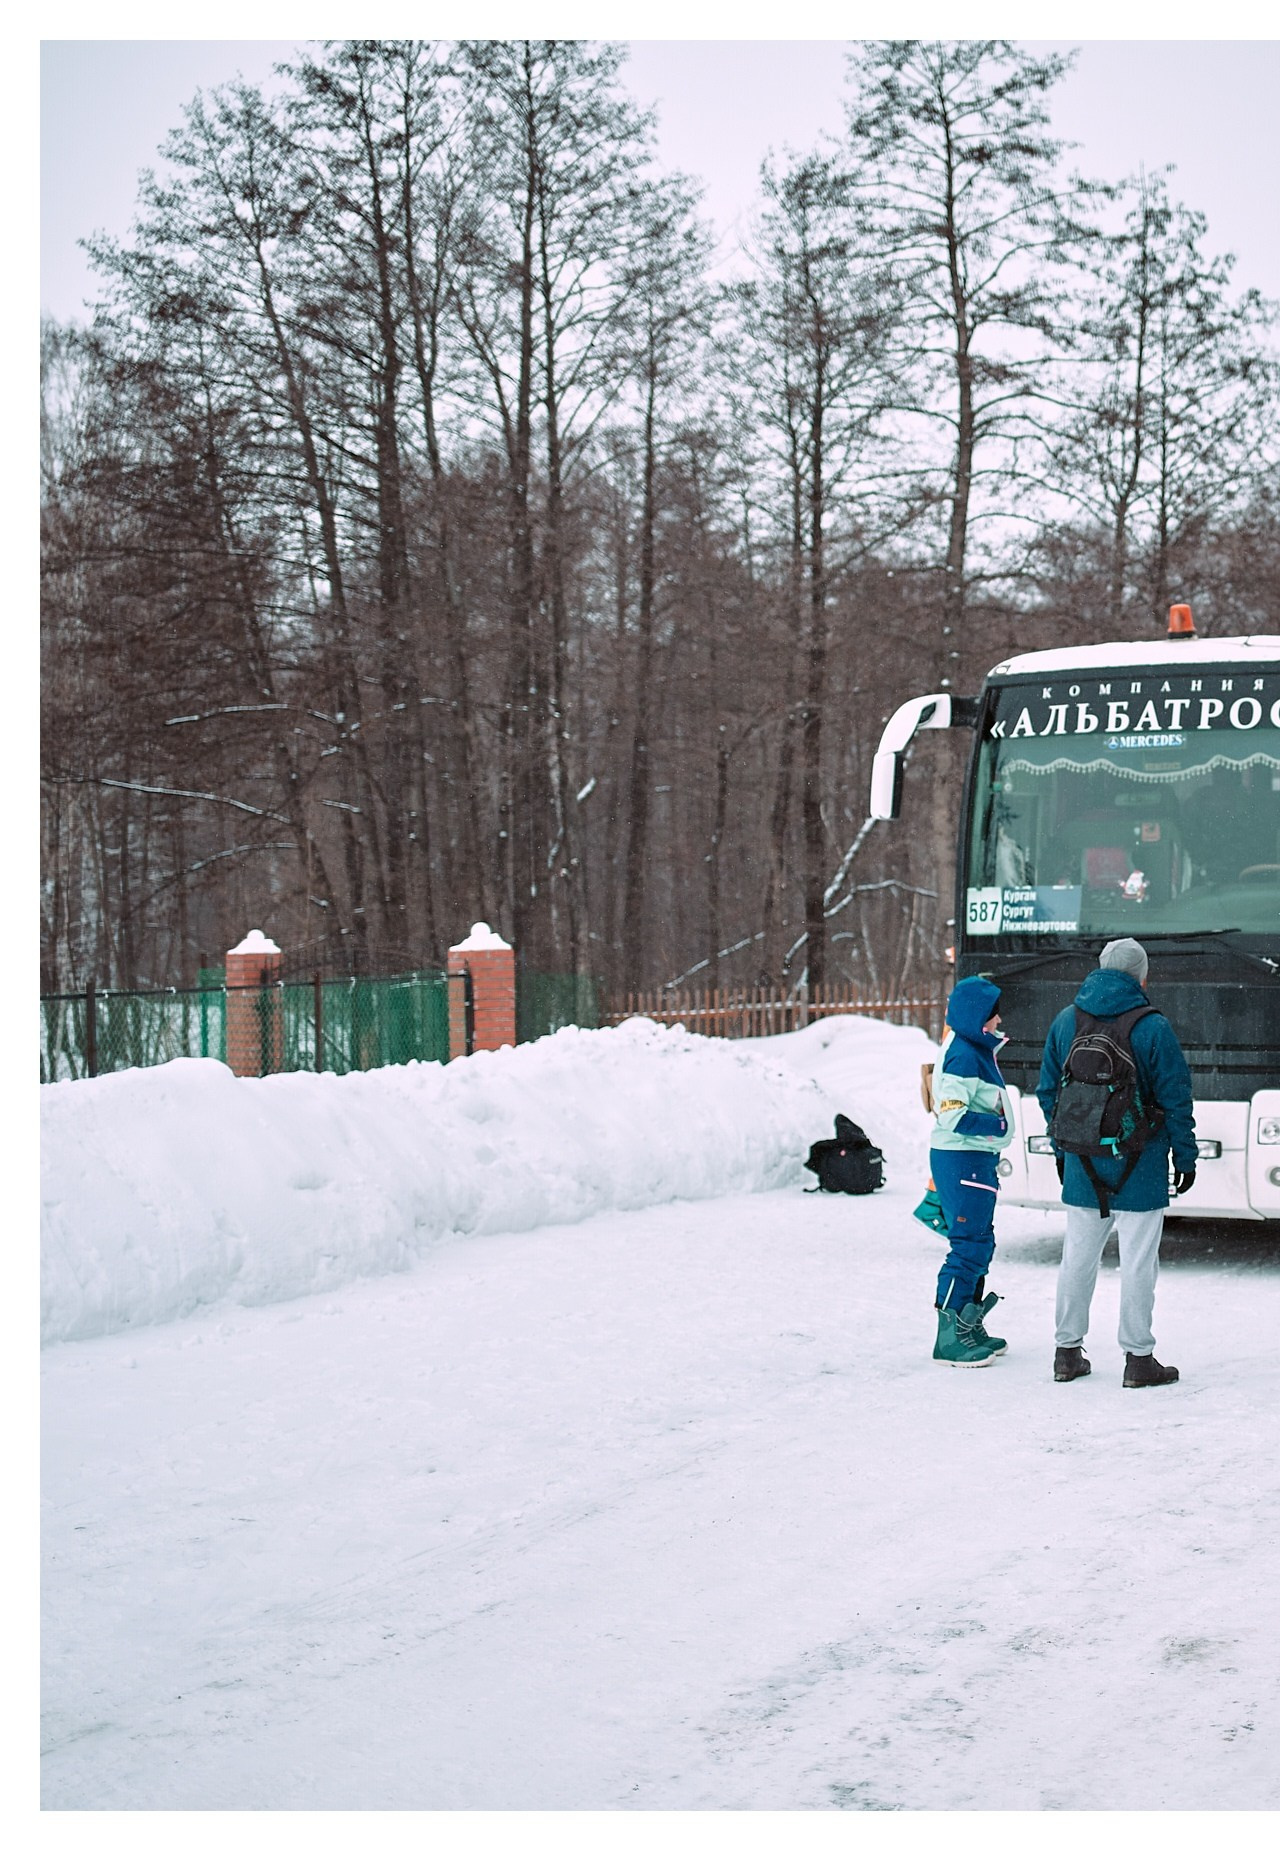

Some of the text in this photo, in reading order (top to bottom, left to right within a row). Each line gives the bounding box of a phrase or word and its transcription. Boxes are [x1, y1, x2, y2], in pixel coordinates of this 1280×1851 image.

[1041, 678, 1265, 700] КОМПАНИЯ
[1119, 734, 1183, 749] MERCEDES
[1003, 891, 1037, 903] Курган
[969, 901, 999, 923] 587
[1003, 905, 1035, 918] Сургут
[1002, 920, 1077, 933] Нижневартовск
